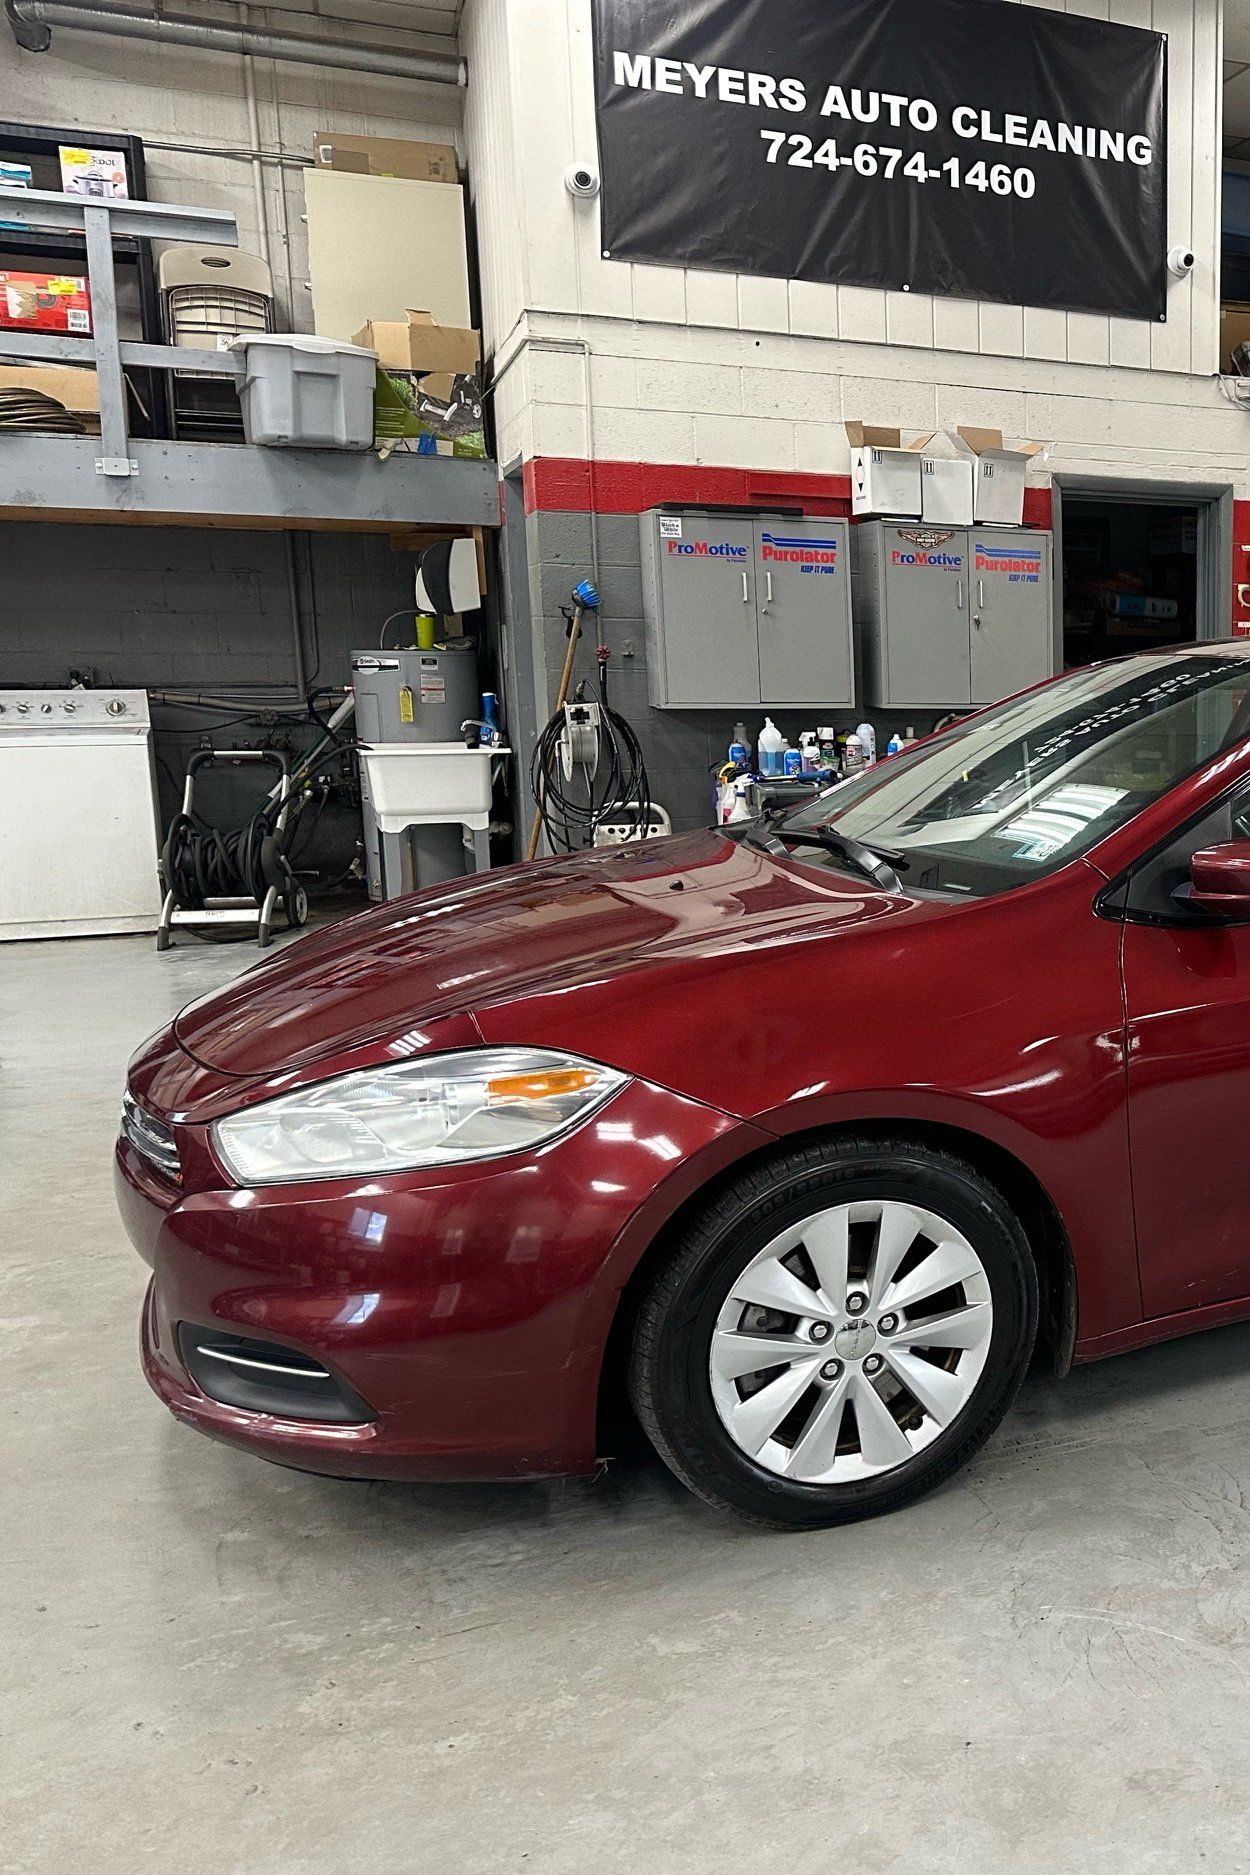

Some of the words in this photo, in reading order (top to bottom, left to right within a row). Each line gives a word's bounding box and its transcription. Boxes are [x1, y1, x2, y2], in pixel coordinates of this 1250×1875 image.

[613, 51, 808, 113] MEYERS
[819, 84, 939, 133] AUTO
[951, 106, 1154, 166] CLEANING
[760, 129, 1037, 199] 724-674-1460
[667, 540, 747, 557] ProMotive
[761, 545, 837, 564] Purolator
[891, 550, 962, 566] ProMotive
[975, 555, 1041, 573] Purolator
[800, 565, 814, 574] KEEP
[821, 566, 835, 575] PURE
[1008, 574, 1020, 582] KEEP
